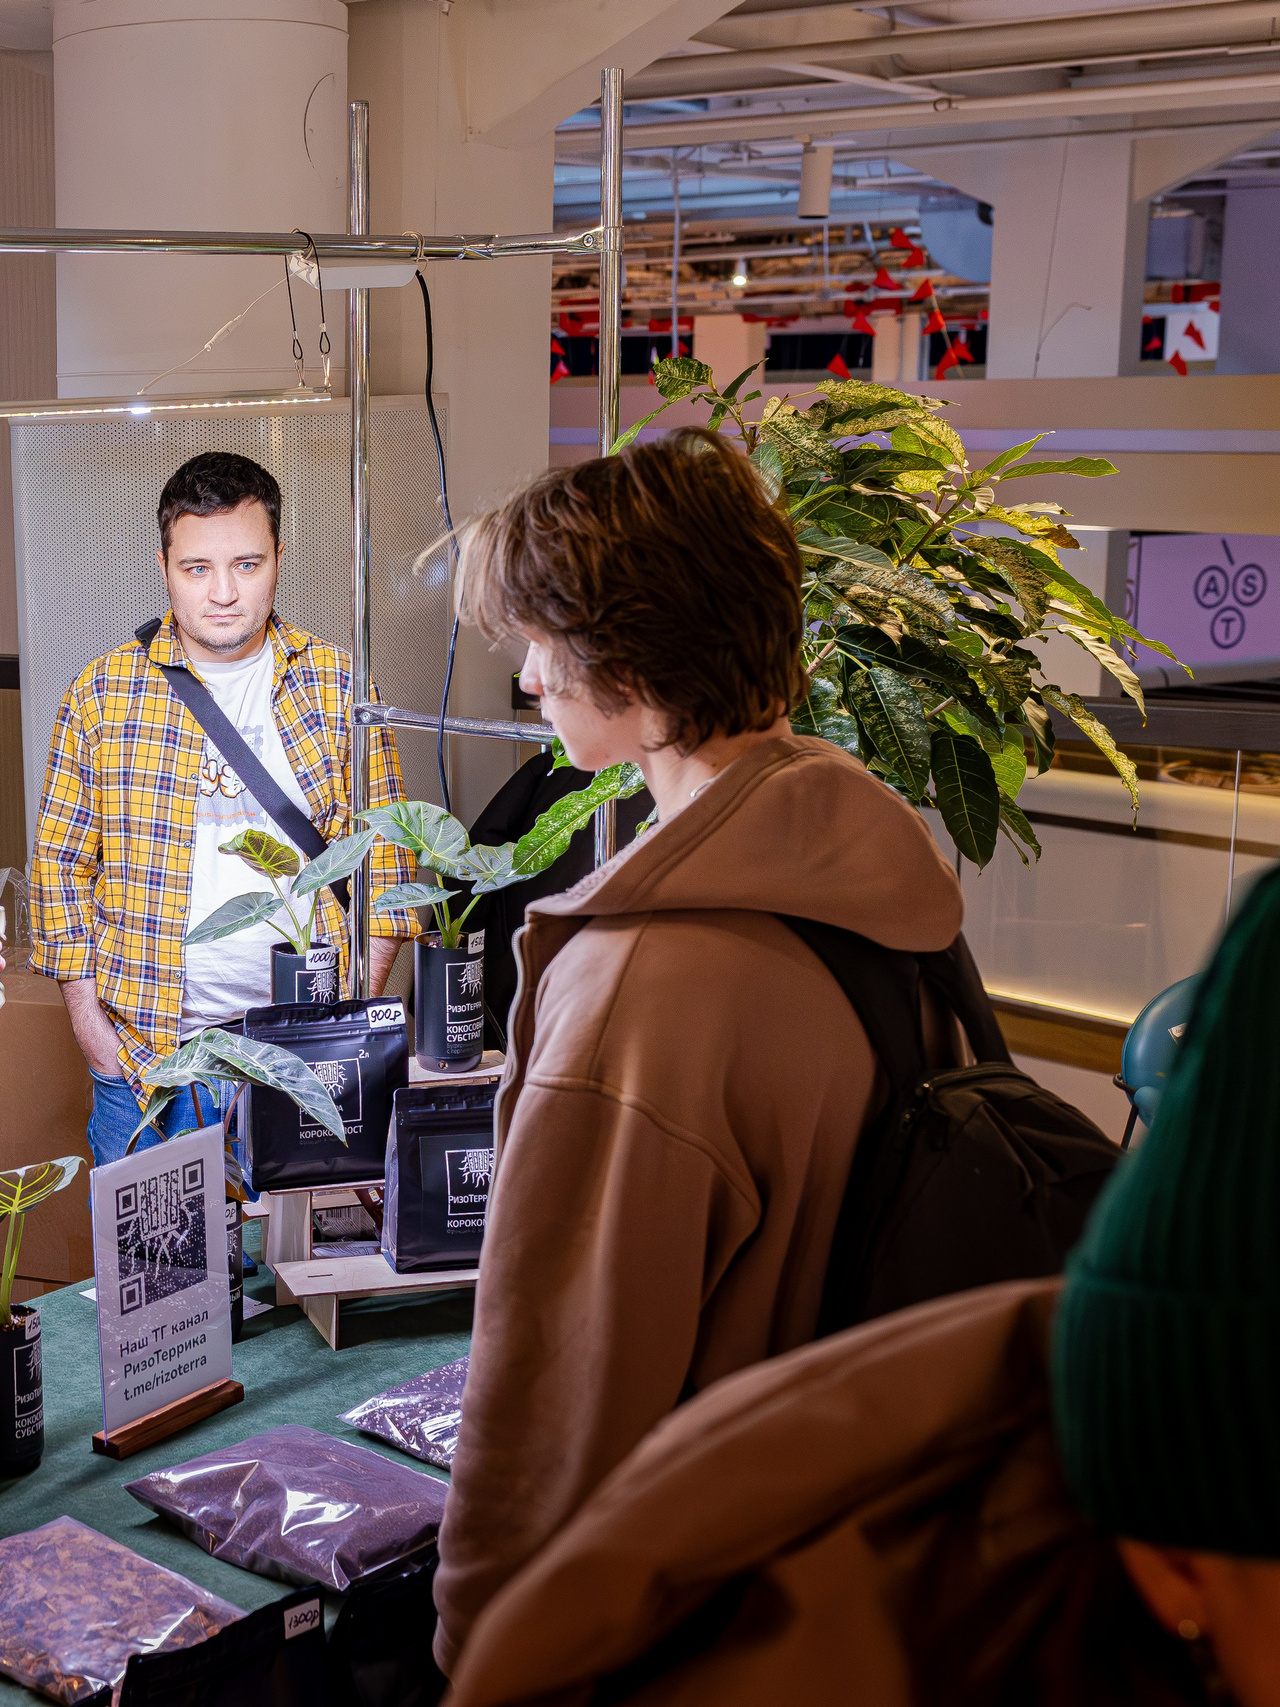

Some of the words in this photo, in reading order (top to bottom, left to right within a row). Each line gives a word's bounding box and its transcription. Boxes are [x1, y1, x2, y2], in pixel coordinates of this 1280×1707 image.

[446, 1030, 482, 1043] СУБСТРАТ
[120, 1336, 148, 1357] Наш
[152, 1324, 167, 1342] ТГ
[171, 1310, 208, 1335] канал
[124, 1333, 206, 1379] РизоТеррика
[124, 1355, 207, 1401] t.me/rizoterra
